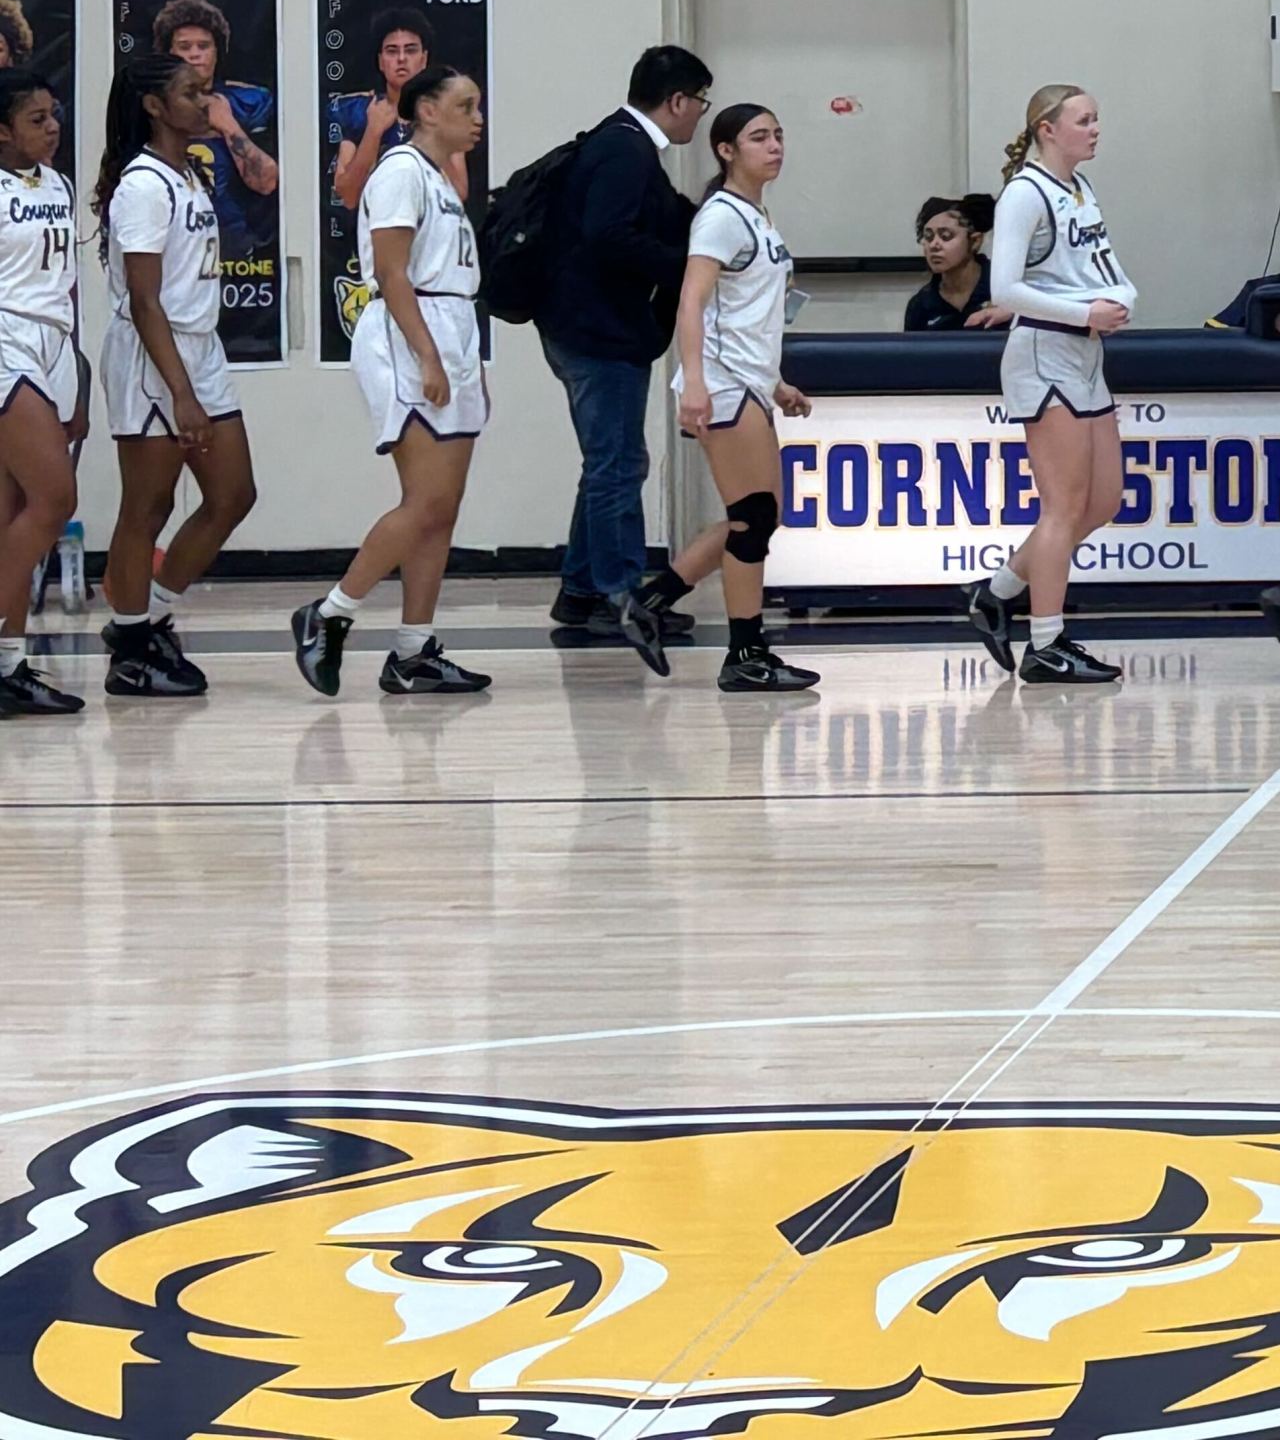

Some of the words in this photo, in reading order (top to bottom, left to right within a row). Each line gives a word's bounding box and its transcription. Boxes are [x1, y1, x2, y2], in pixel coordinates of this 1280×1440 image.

[41, 227, 69, 270] 14
[222, 283, 272, 307] 025
[1131, 403, 1165, 422] TO
[940, 544, 1008, 572] HIG
[1071, 541, 1208, 570] CHOOL
